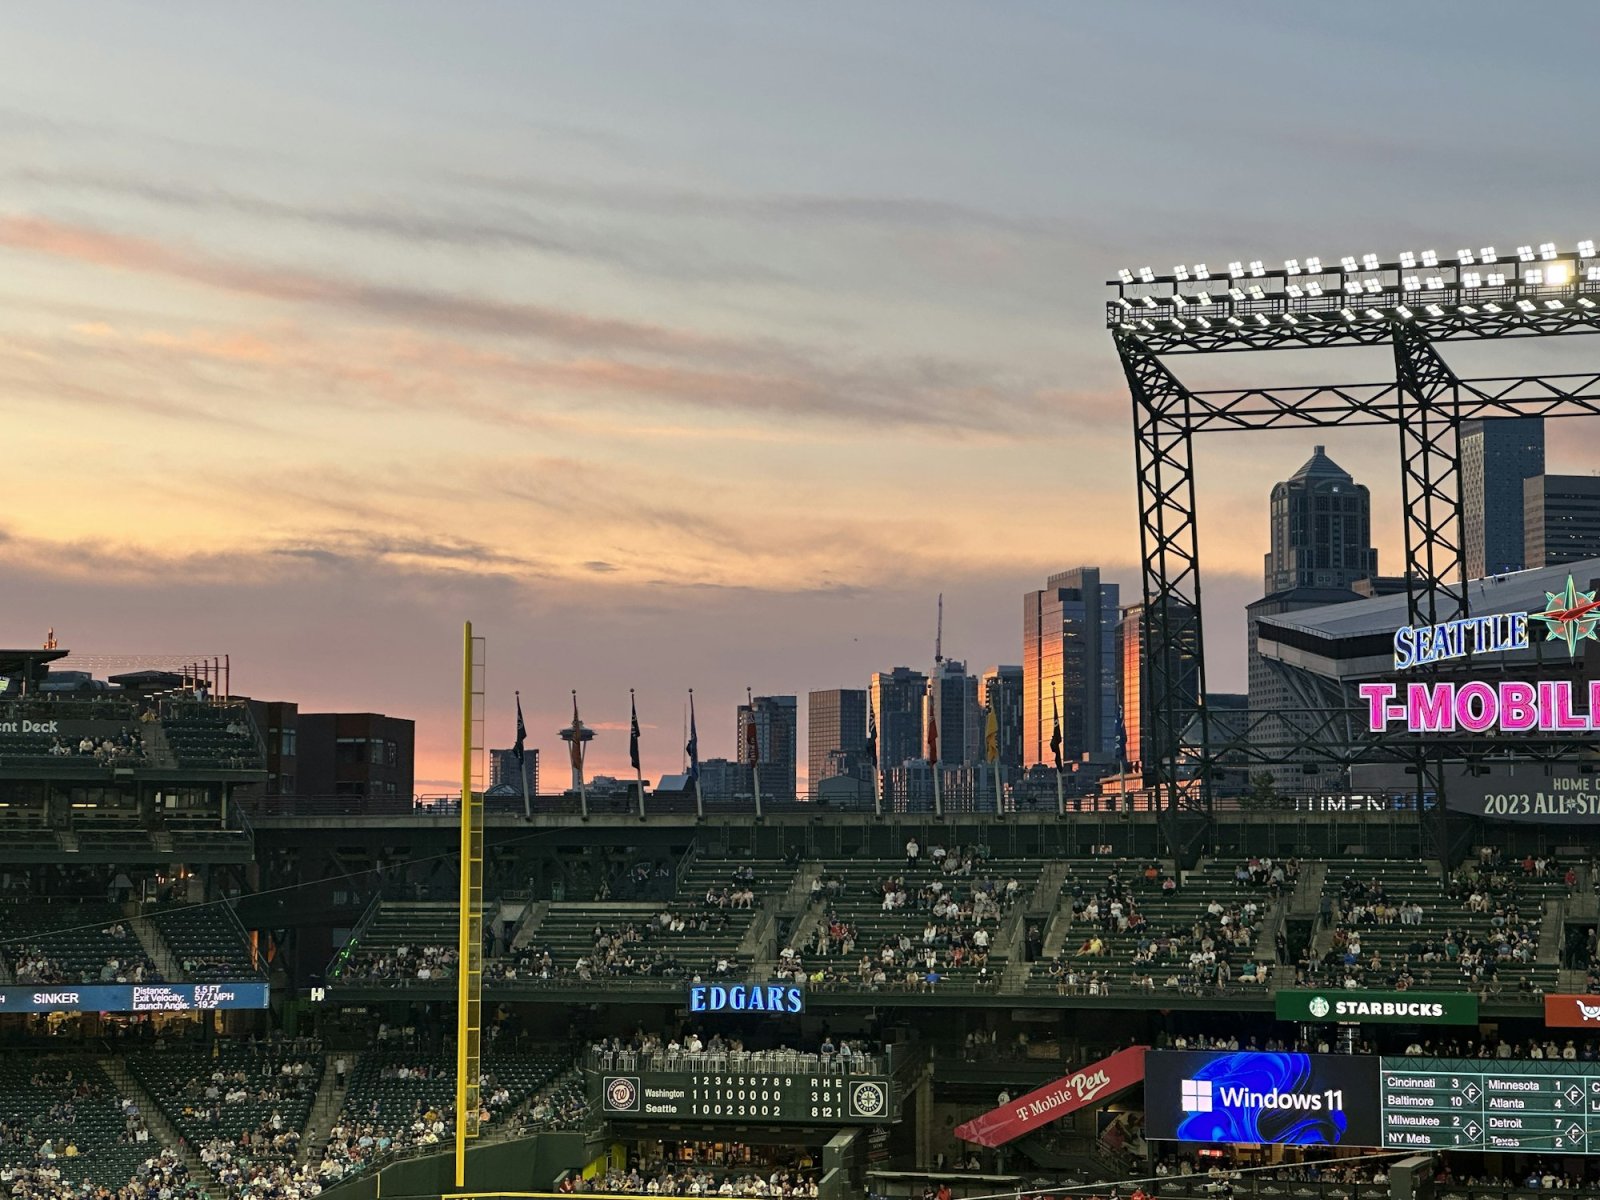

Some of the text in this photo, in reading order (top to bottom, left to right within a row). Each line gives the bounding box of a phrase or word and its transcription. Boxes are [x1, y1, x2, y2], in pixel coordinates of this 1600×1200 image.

[1394, 611, 1529, 671] SEATTLE
[0, 719, 58, 733] nt Deck
[1553, 778, 1590, 791] HOME
[1484, 794, 1531, 815] 2023
[133, 985, 221, 995] Distance: 5.5 FT
[33, 992, 79, 1004] SINKER
[133, 994, 149, 1002] Exit
[151, 994, 185, 1003] Velocity:
[214, 993, 234, 1001] MPH
[691, 985, 802, 1013] EDGAR'S
[133, 1002, 162, 1010] Launch
[164, 1002, 190, 1010] Angle:
[1335, 1001, 1443, 1017] STARBUCKS
[692, 1076, 842, 1088] 1 2 3 4 5 6 7 8 9 R H E
[1387, 1077, 1459, 1089] Cincinnati 3
[1488, 1079, 1561, 1091] Minnesota 1
[645, 1089, 841, 1103] Washington 1 1 1 0 0 0 0 0 3 8 1
[1220, 1087, 1343, 1111] Windows 11
[1468, 1088, 1476, 1098] F
[1571, 1090, 1579, 1100] F
[1029, 1089, 1072, 1117] Mobile
[1387, 1095, 1463, 1107] Baltimore 10
[1489, 1098, 1562, 1109] Atlanta 4
[645, 1103, 841, 1118] Seattle 1 0 0 2 3 0 0 2 8 12 1
[1388, 1115, 1460, 1126] Milwaukee 2
[1489, 1118, 1562, 1129] Detroit 7
[1469, 1126, 1477, 1136] F
[1388, 1133, 1460, 1145] NY Mets 1
[1490, 1135, 1563, 1147] Texas 2
